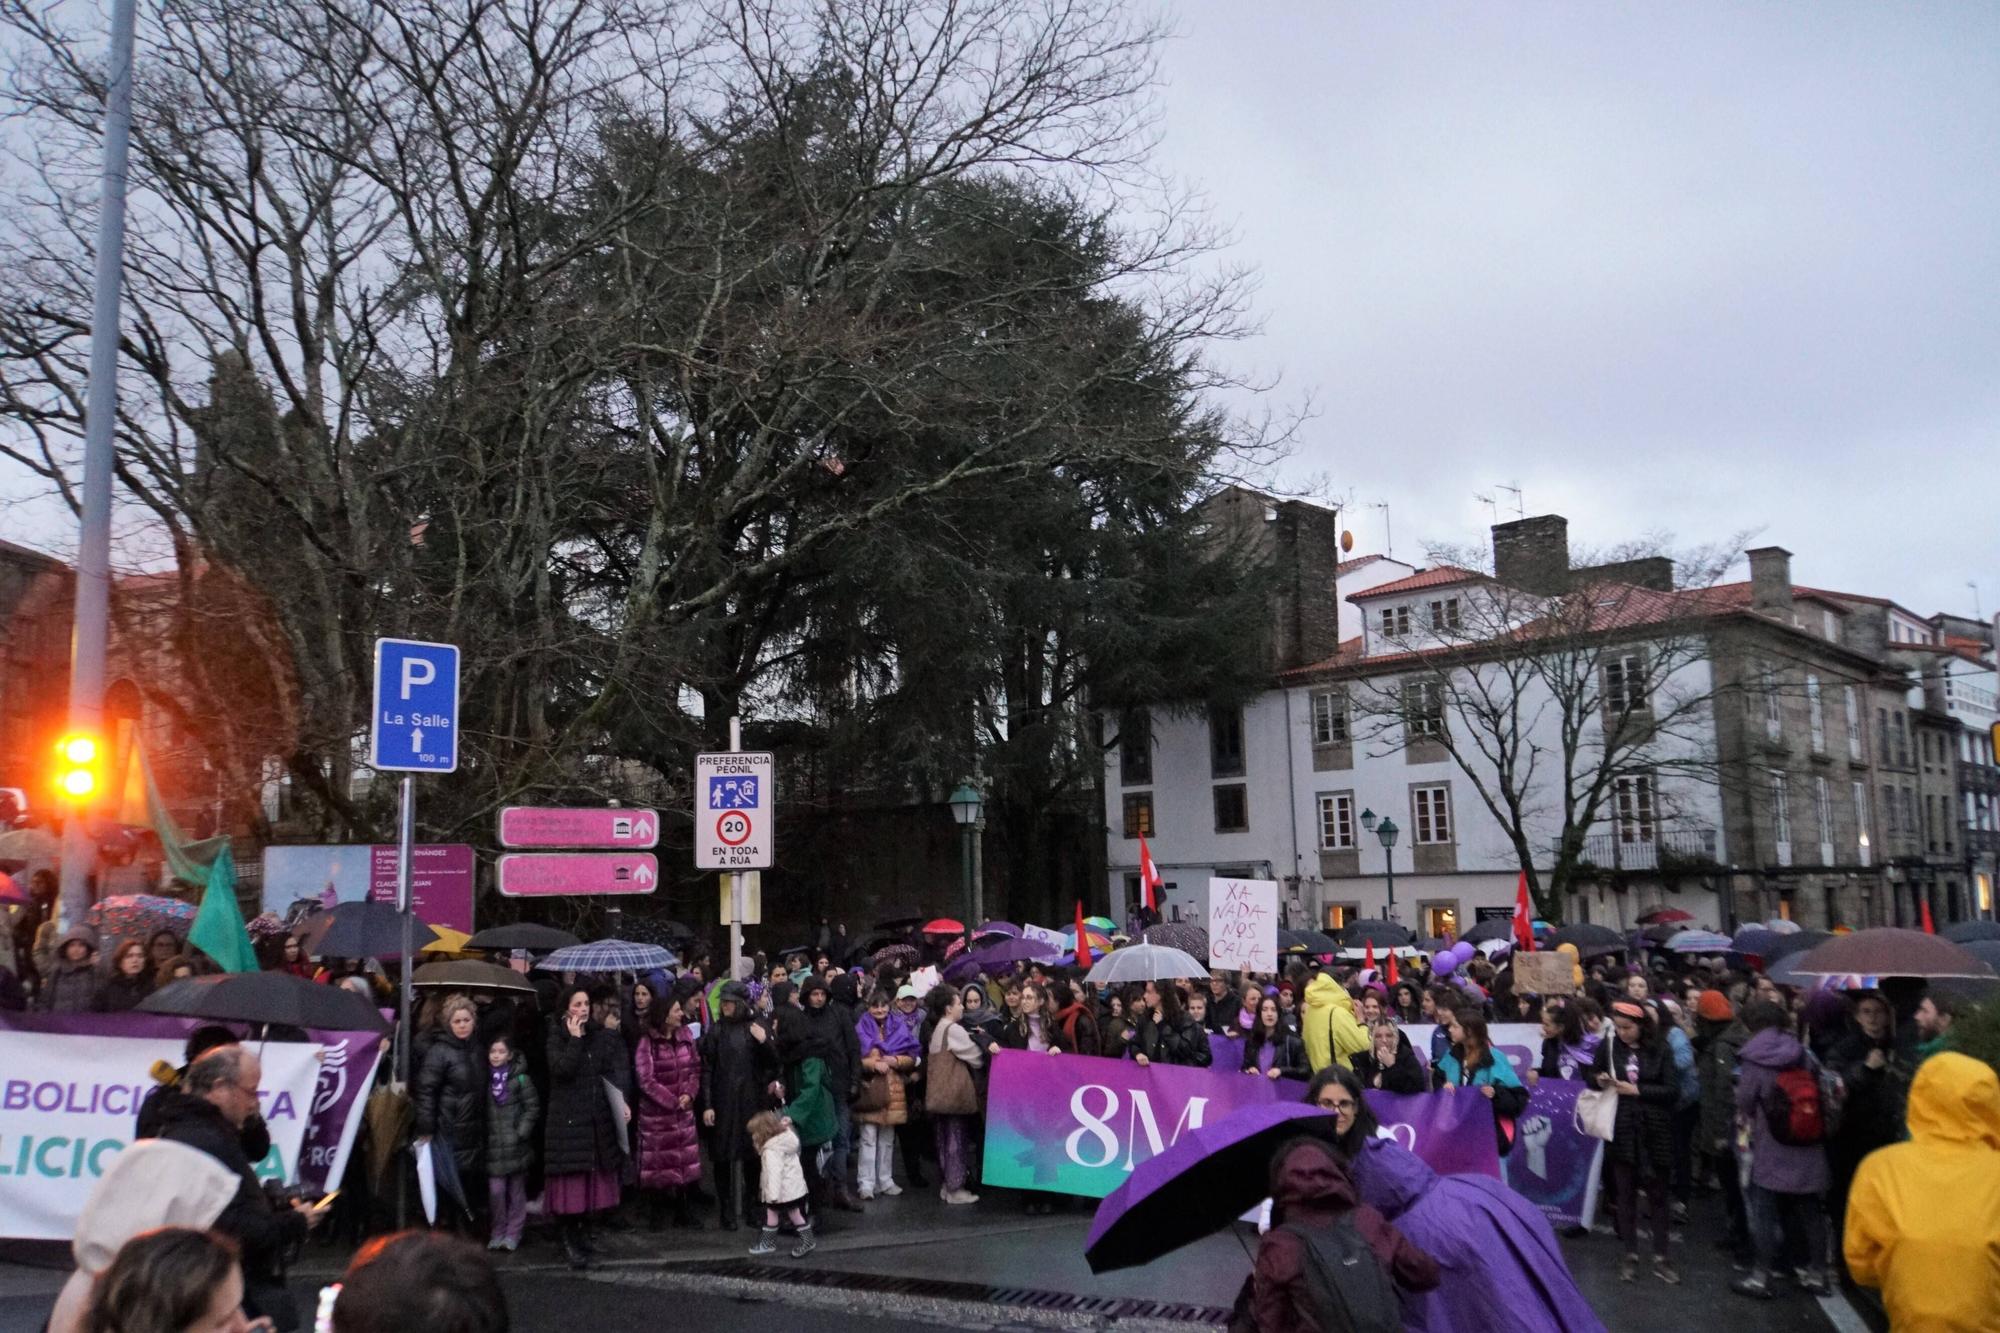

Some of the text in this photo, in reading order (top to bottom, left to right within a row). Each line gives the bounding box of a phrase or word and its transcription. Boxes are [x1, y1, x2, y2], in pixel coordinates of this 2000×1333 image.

[401, 656, 437, 700] P
[383, 710, 451, 728] La Salle
[418, 753, 449, 764] 100 m
[699, 756, 770, 766] PREFERENCIA
[716, 765, 753, 774] PEONIL
[724, 821, 744, 833] 20
[712, 846, 759, 856] EN TODA
[719, 857, 727, 865] A
[1226, 883, 1252, 900] XA
[1213, 901, 1267, 920] NADA
[1212, 940, 1264, 962] CALA
[1065, 1084, 1209, 1172] 8M
